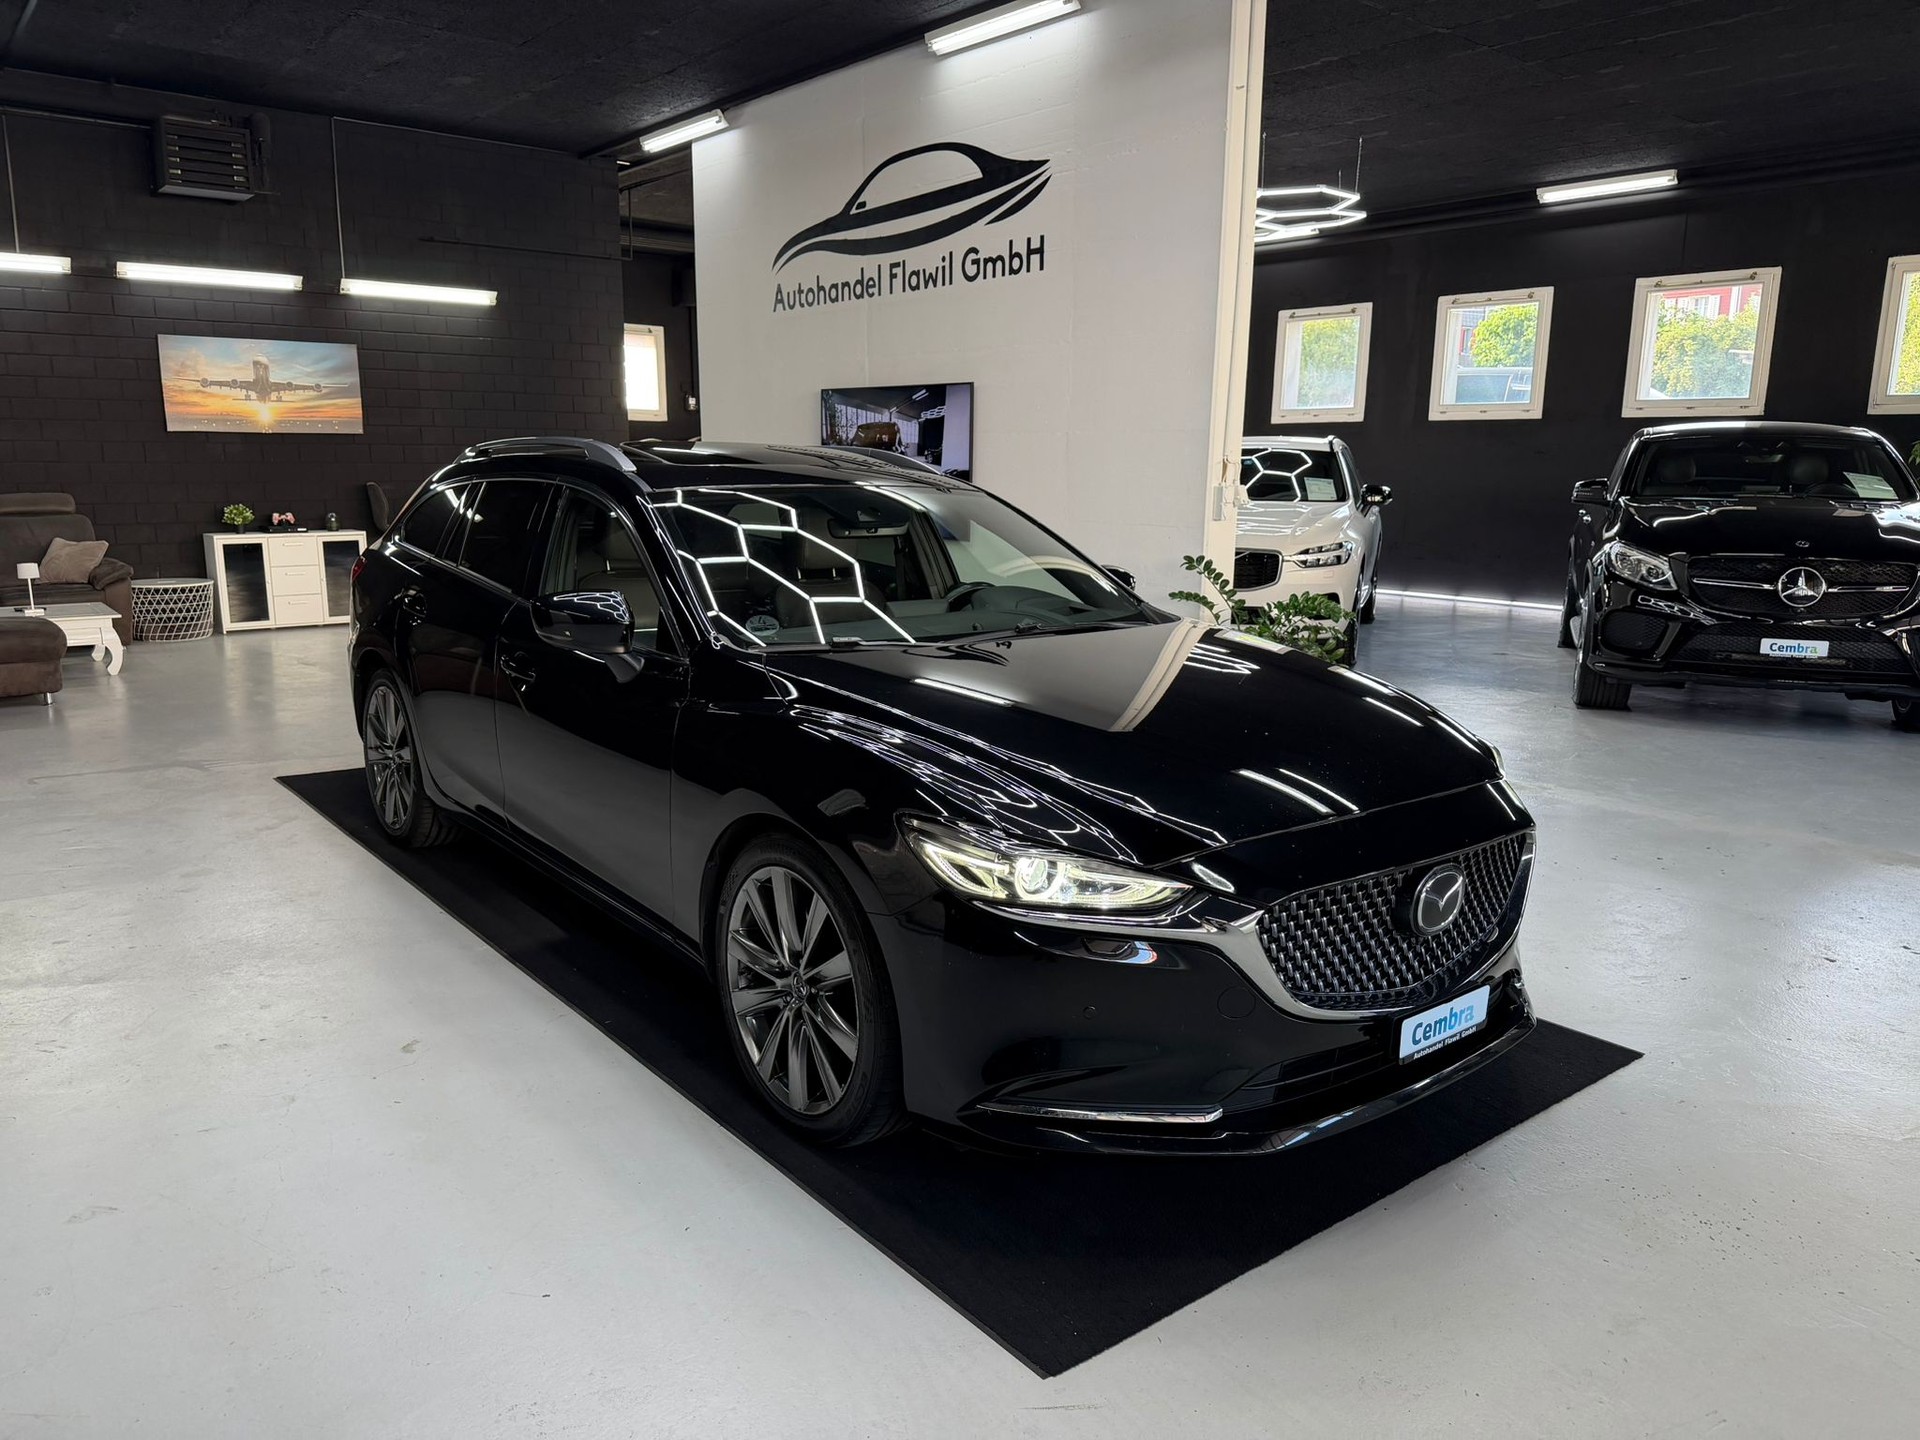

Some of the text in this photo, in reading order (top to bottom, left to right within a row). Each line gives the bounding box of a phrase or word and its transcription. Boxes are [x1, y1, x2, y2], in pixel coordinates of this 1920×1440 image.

[773, 234, 1045, 313] Autohandel Flawil GmbH
[1769, 642, 1819, 654] Cembra
[1411, 1004, 1475, 1046] Cembra
[1413, 1025, 1477, 1060] Autohandel Flawil GmbH
